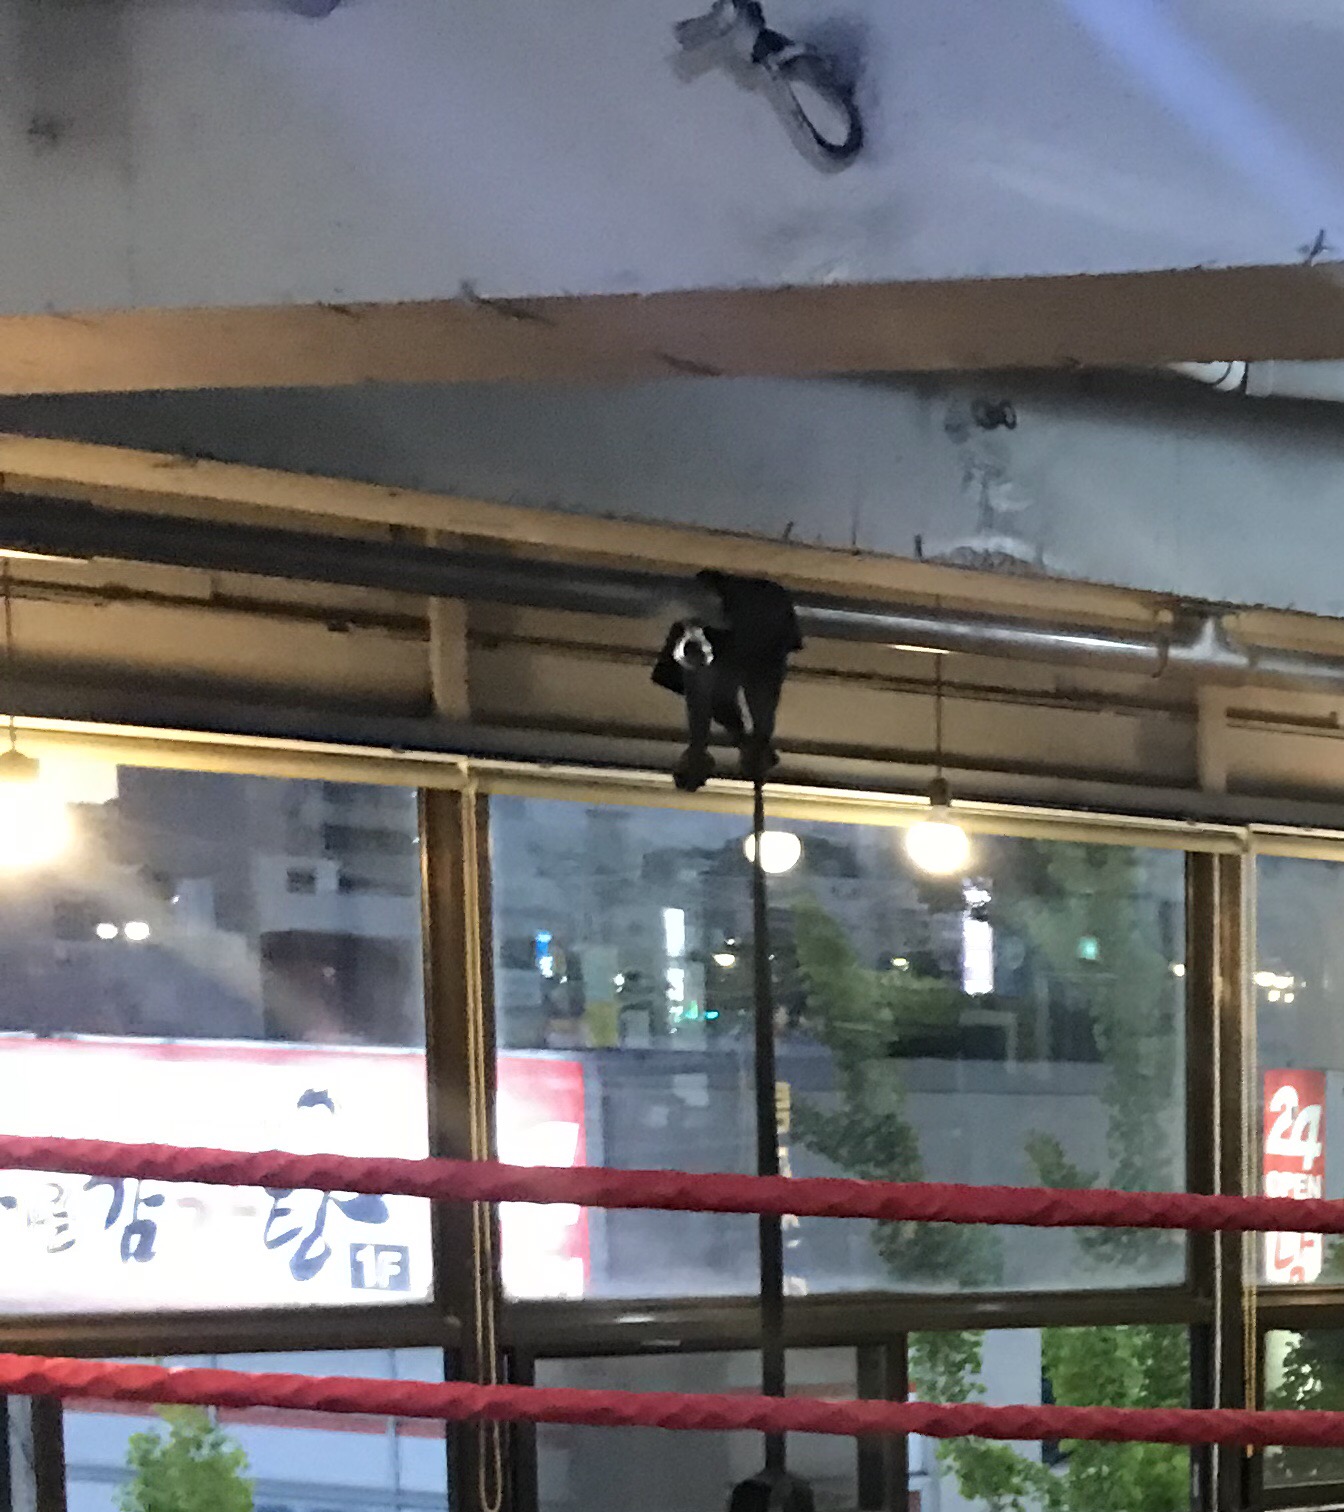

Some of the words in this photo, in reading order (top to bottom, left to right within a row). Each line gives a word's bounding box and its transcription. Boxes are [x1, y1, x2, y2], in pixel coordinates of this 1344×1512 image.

[1266, 1085, 1322, 1170] 24
[1265, 1170, 1322, 1200] OPEN
[356, 1245, 404, 1289] 1F
